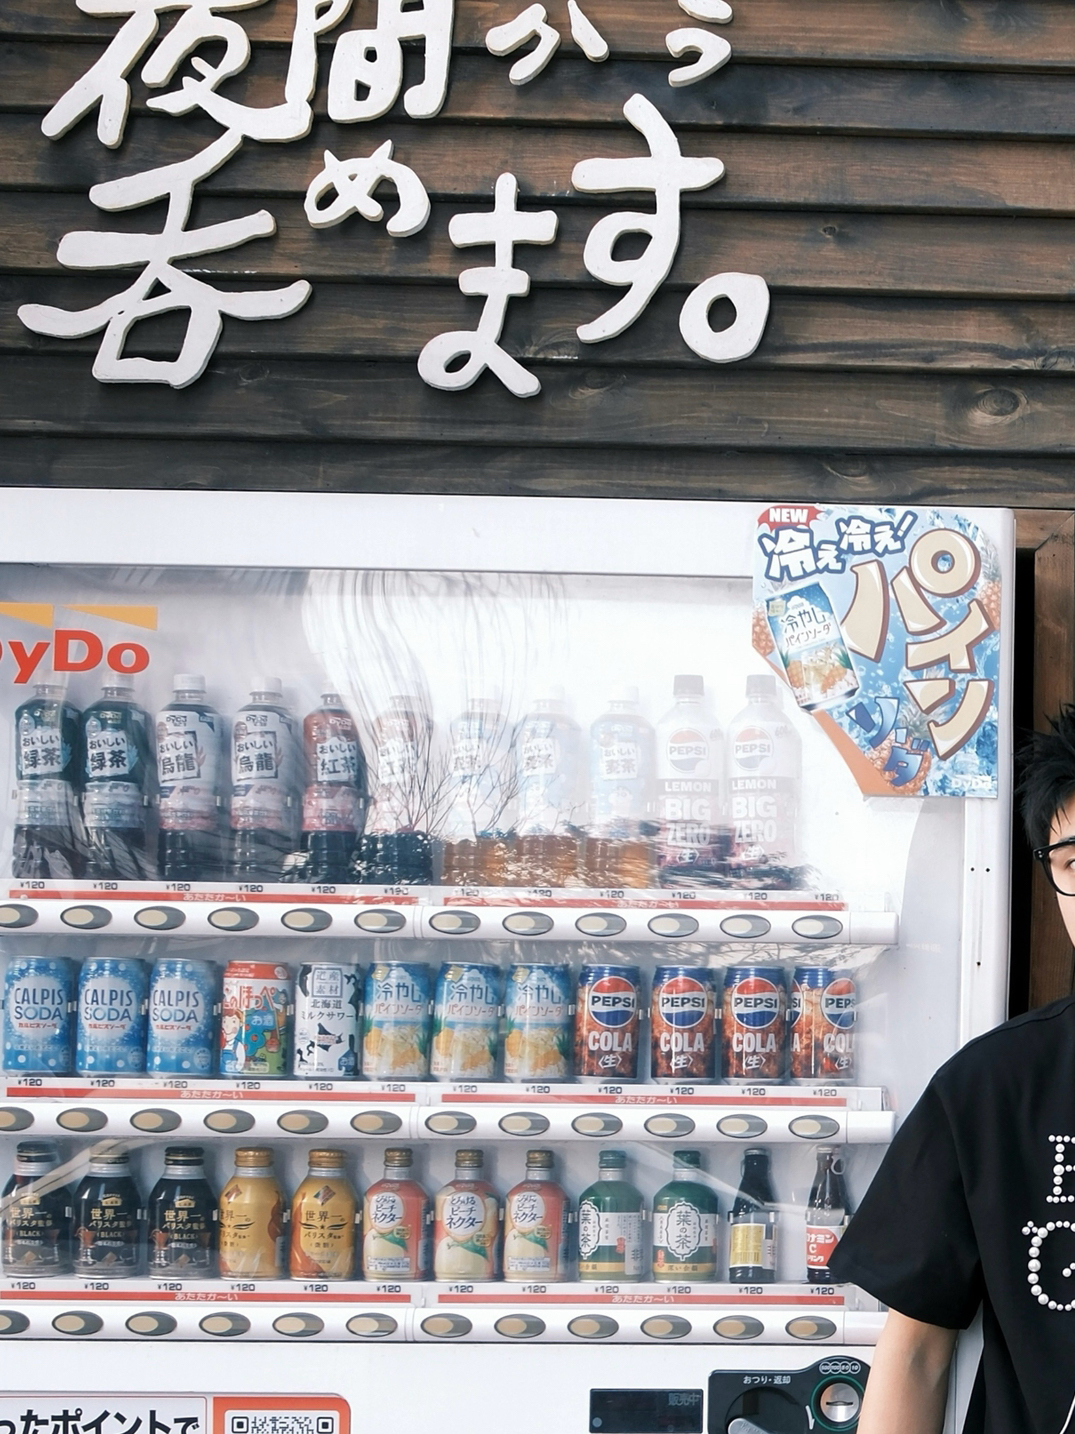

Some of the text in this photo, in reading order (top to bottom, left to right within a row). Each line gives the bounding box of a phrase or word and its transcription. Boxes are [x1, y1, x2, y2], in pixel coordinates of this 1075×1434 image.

[17, 127, 770, 397] 呑めます。
[768, 507, 809, 524] NEW
[0, 629, 150, 684] yDo
[664, 781, 712, 792] LEMON
[732, 779, 777, 791] LEMON
[665, 797, 712, 821] BIG
[732, 795, 778, 819] BIG
[14, 987, 64, 1006] CALPIS
[84, 987, 133, 1006] CALPIS
[152, 988, 200, 1007] CALPIS
[311, 1000, 343, 1009] 北海道
[591, 995, 636, 1007] PEPSI
[661, 996, 706, 1009] PEPSI
[733, 996, 779, 1009] PEPSI
[14, 1006, 64, 1021] SODA
[84, 1006, 133, 1022] SODA
[152, 1006, 200, 1022] SODA
[300, 1011, 354, 1021] ミルクサワー
[588, 1031, 633, 1052] COLA
[660, 1031, 705, 1053] COLA
[732, 1032, 777, 1053] COLA
[372, 1213, 403, 1223] ネクター
[446, 1216, 483, 1230] ネクター
[513, 1212, 543, 1223] ネクター
[676, 1210, 692, 1249] 葉の茶
[809, 1244, 817, 1253] C
